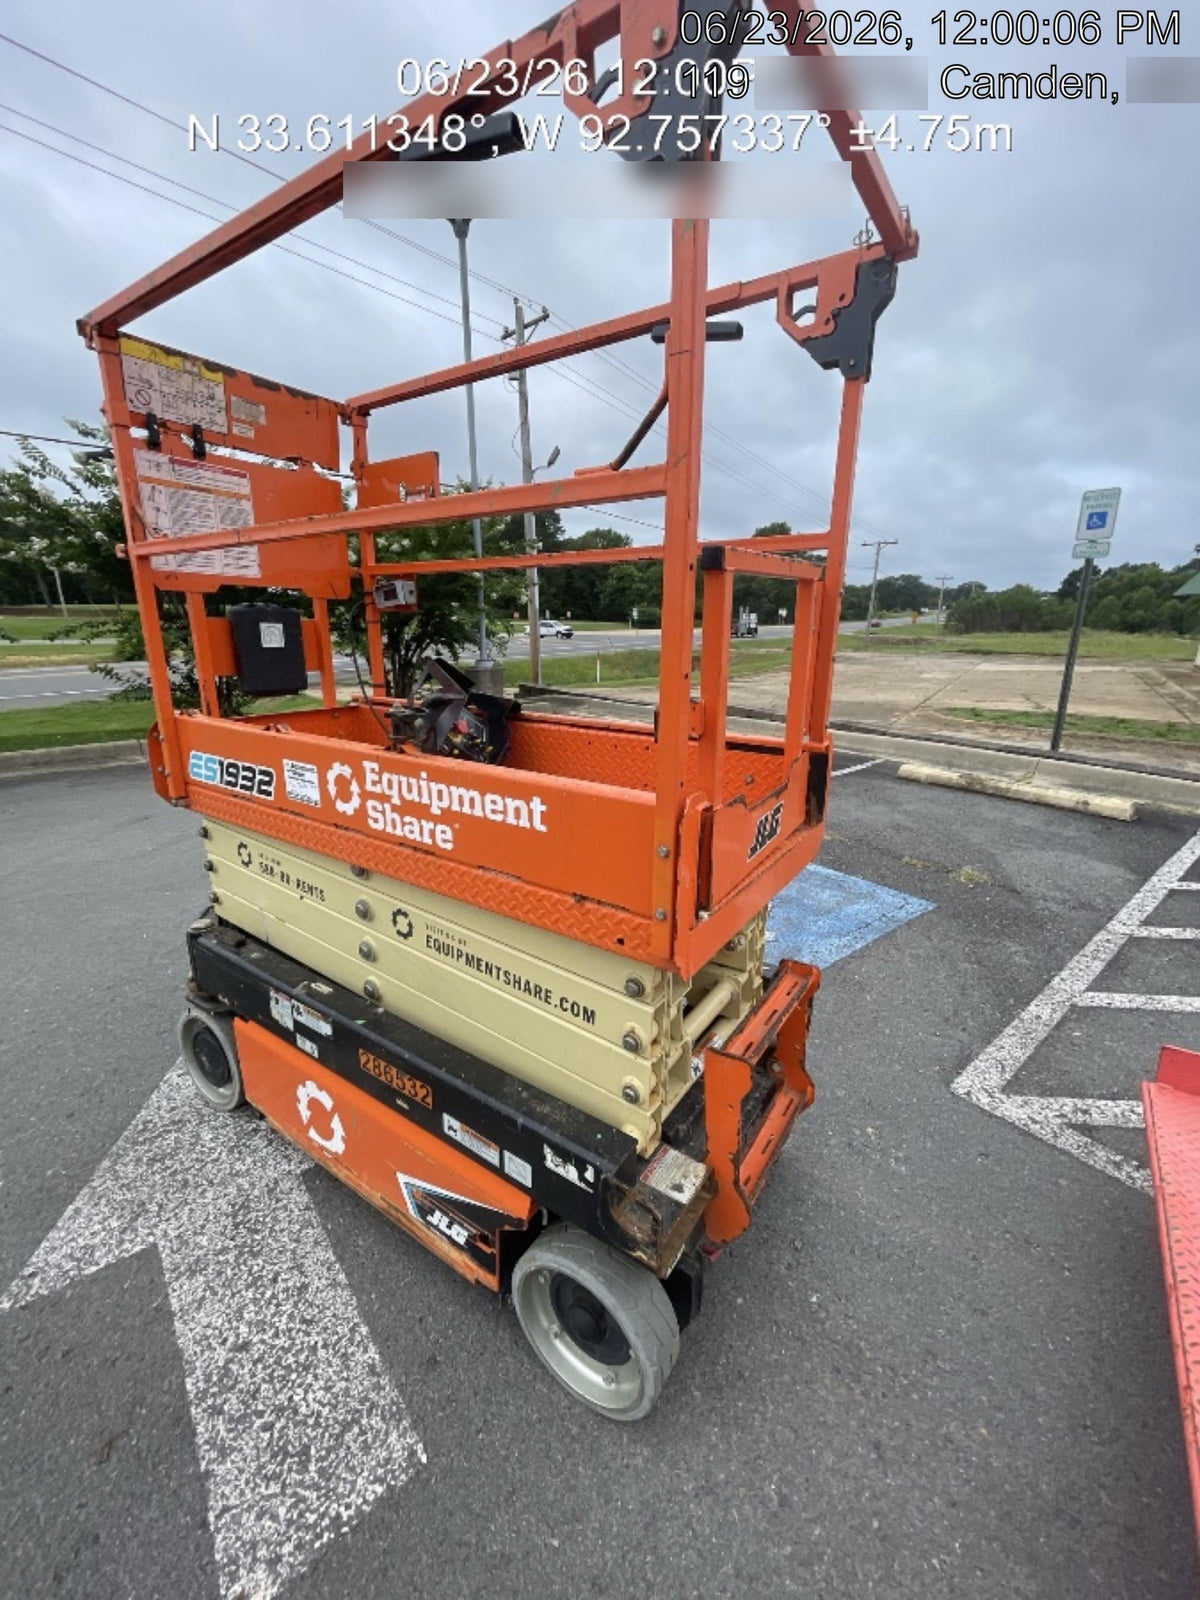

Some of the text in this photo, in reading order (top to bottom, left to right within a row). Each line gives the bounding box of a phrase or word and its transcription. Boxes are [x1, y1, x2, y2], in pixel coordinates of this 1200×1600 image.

[189, 751, 276, 799] ES1932
[362, 760, 548, 832] Equipment
[365, 799, 454, 850] Share
[425, 934, 597, 1026] EQUIPMENTSHARE.COM
[361, 1051, 431, 1106] 286532
[426, 1209, 469, 1247] JLG
